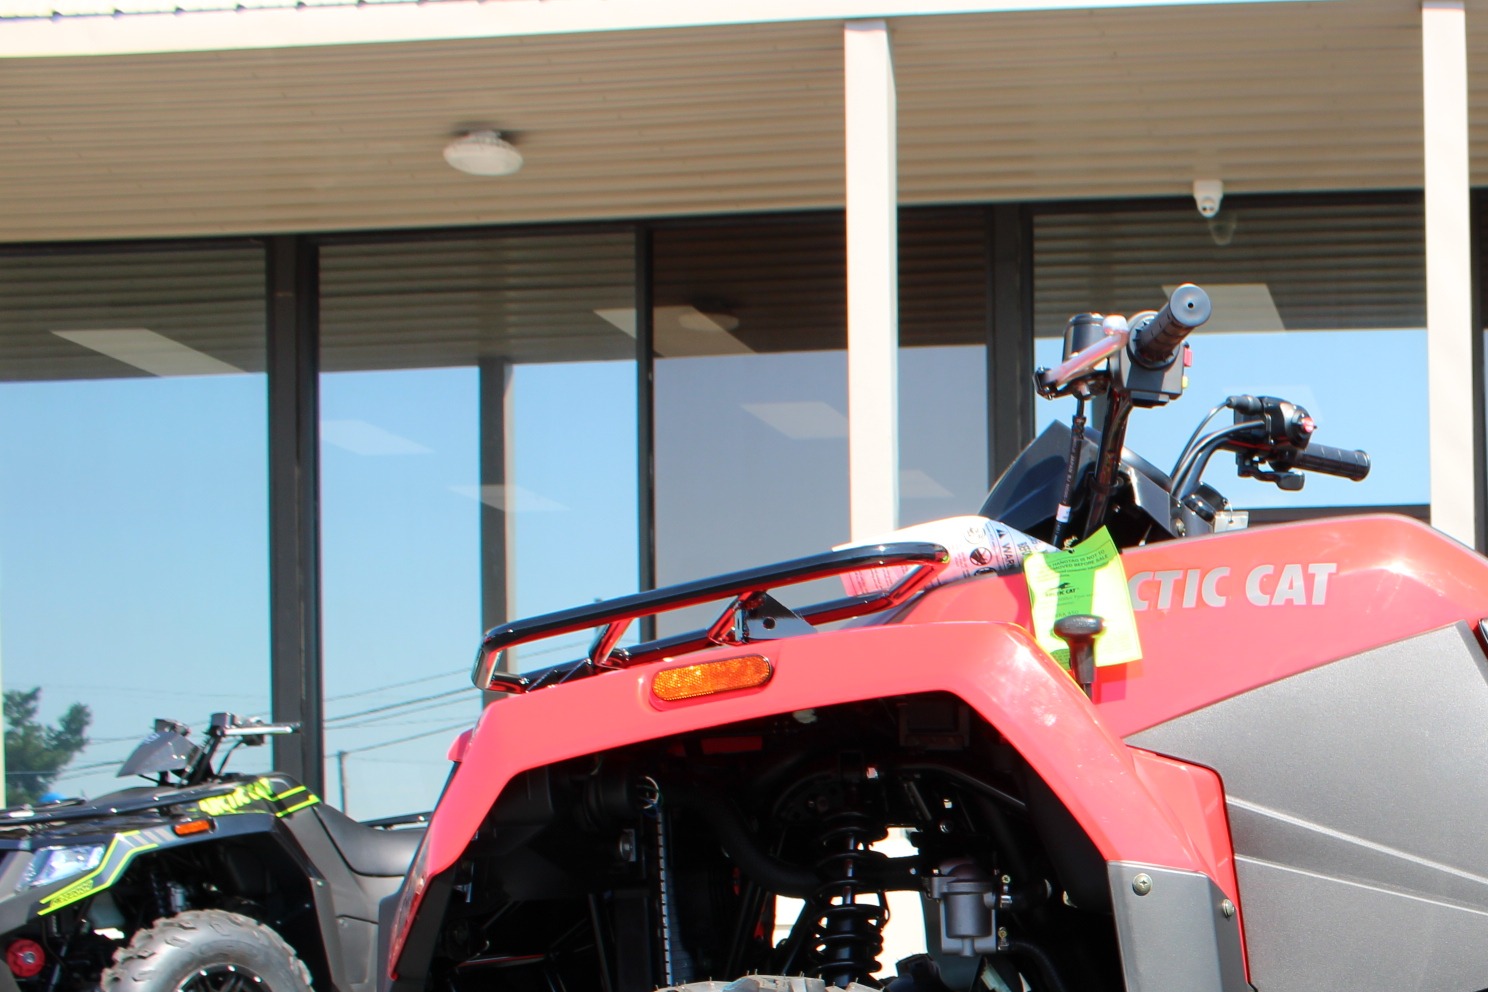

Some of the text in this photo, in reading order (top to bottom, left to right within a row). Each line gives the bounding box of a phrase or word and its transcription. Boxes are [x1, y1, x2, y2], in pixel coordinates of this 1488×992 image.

[1085, 552, 1097, 560] NOT
[1094, 553, 1108, 562] SALE
[1127, 563, 1337, 612] CTIC CAT
